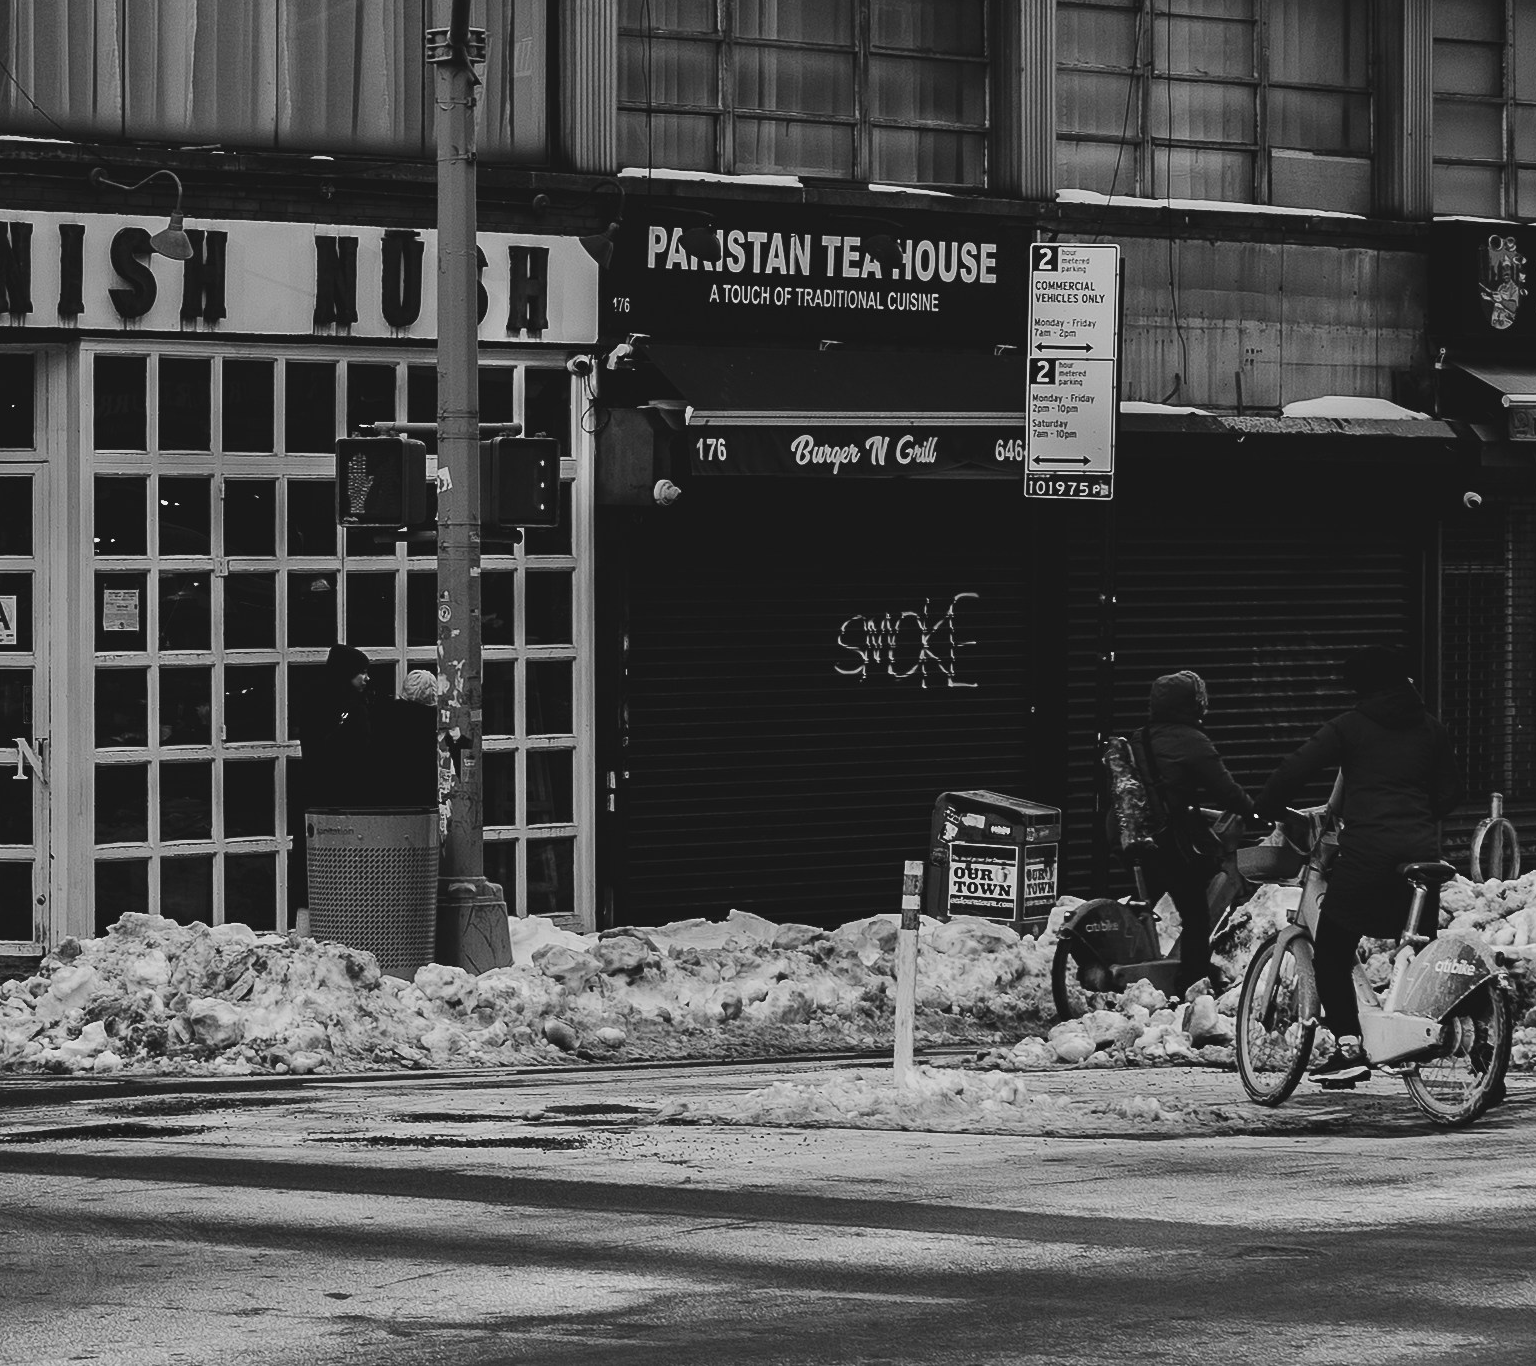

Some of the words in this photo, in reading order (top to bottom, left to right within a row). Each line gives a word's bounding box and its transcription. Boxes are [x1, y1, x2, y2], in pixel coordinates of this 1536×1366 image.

[1038, 247, 1052, 270] 2
[1062, 266, 1086, 274] parking
[1035, 280, 1095, 291] COMMERCIAL
[612, 297, 630, 313] 176
[709, 284, 719, 303] A
[723, 285, 770, 305] TOUCH
[774, 287, 792, 306] OF
[796, 288, 883, 310] TRADITIONAL
[887, 291, 939, 312] CUISINE
[1035, 293, 1078, 304] VEHICLES
[1082, 294, 1105, 304] ONLY
[1034, 318, 1064, 328] Monday
[1072, 319, 1096, 329] Friday
[1034, 328, 1051, 337] 7am
[1059, 329, 1077, 339] 2pm
[1036, 360, 1050, 383] 2
[1059, 361, 1074, 369] hour
[1059, 378, 1083, 387] parking
[1032, 394, 1063, 404] Monday
[1071, 394, 1095, 404] Friday
[1032, 404, 1050, 413] 2pm
[1057, 404, 1079, 414] 10pm
[1032, 419, 1068, 429] Saturday
[1032, 429, 1048, 438] 7am
[1056, 429, 1077, 439] 10pm
[696, 438, 727, 461] 176
[790, 434, 861, 474] Burger
[865, 435, 890, 465] N
[896, 434, 939, 465] Grill
[1029, 480, 1089, 496] 101975
[833, 591, 980, 689] SMOKE
[12, 737, 48, 785] N
[953, 866, 993, 882] OUR
[1026, 868, 1046, 881] OUR
[953, 880, 1012, 897] TOWN
[1026, 881, 1055, 896] TOWN
